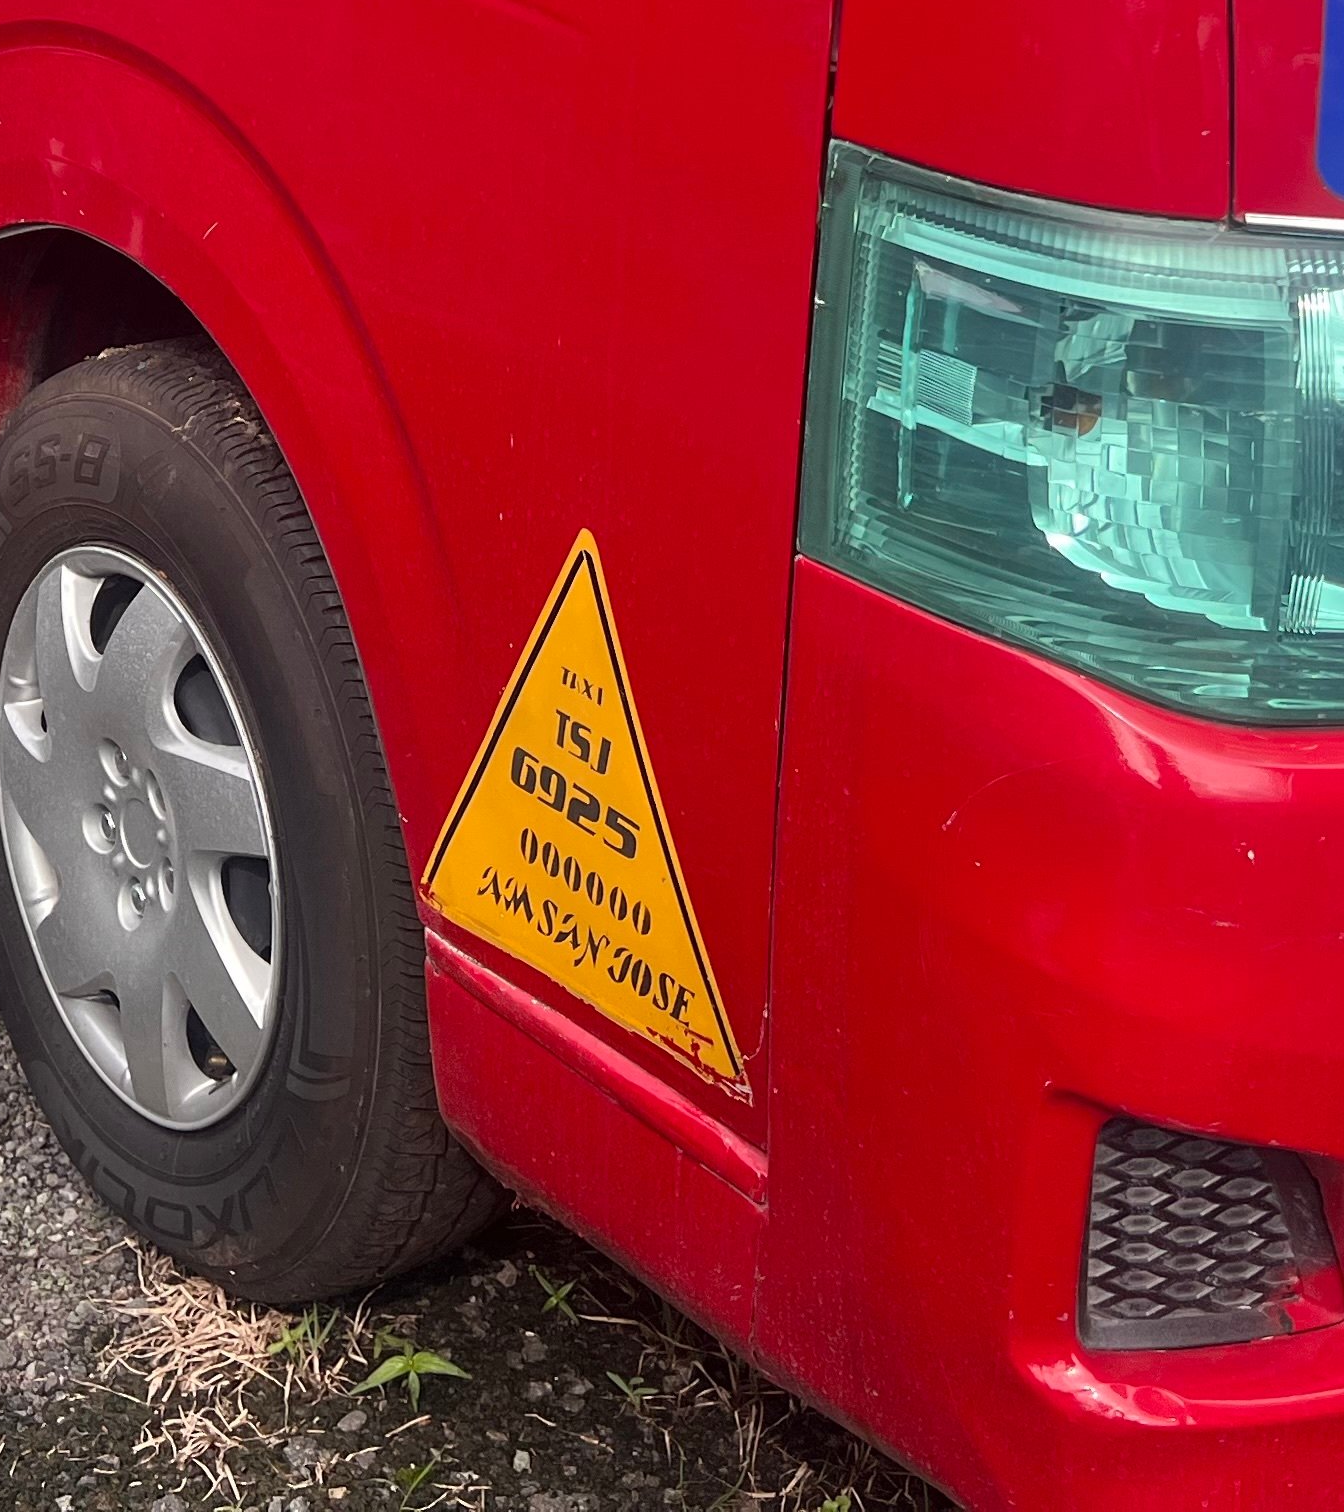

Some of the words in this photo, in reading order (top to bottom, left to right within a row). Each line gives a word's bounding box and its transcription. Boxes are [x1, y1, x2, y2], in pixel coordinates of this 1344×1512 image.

[556, 709, 612, 775] TSJ
[511, 746, 641, 860] 6925
[520, 827, 652, 935] 000000
